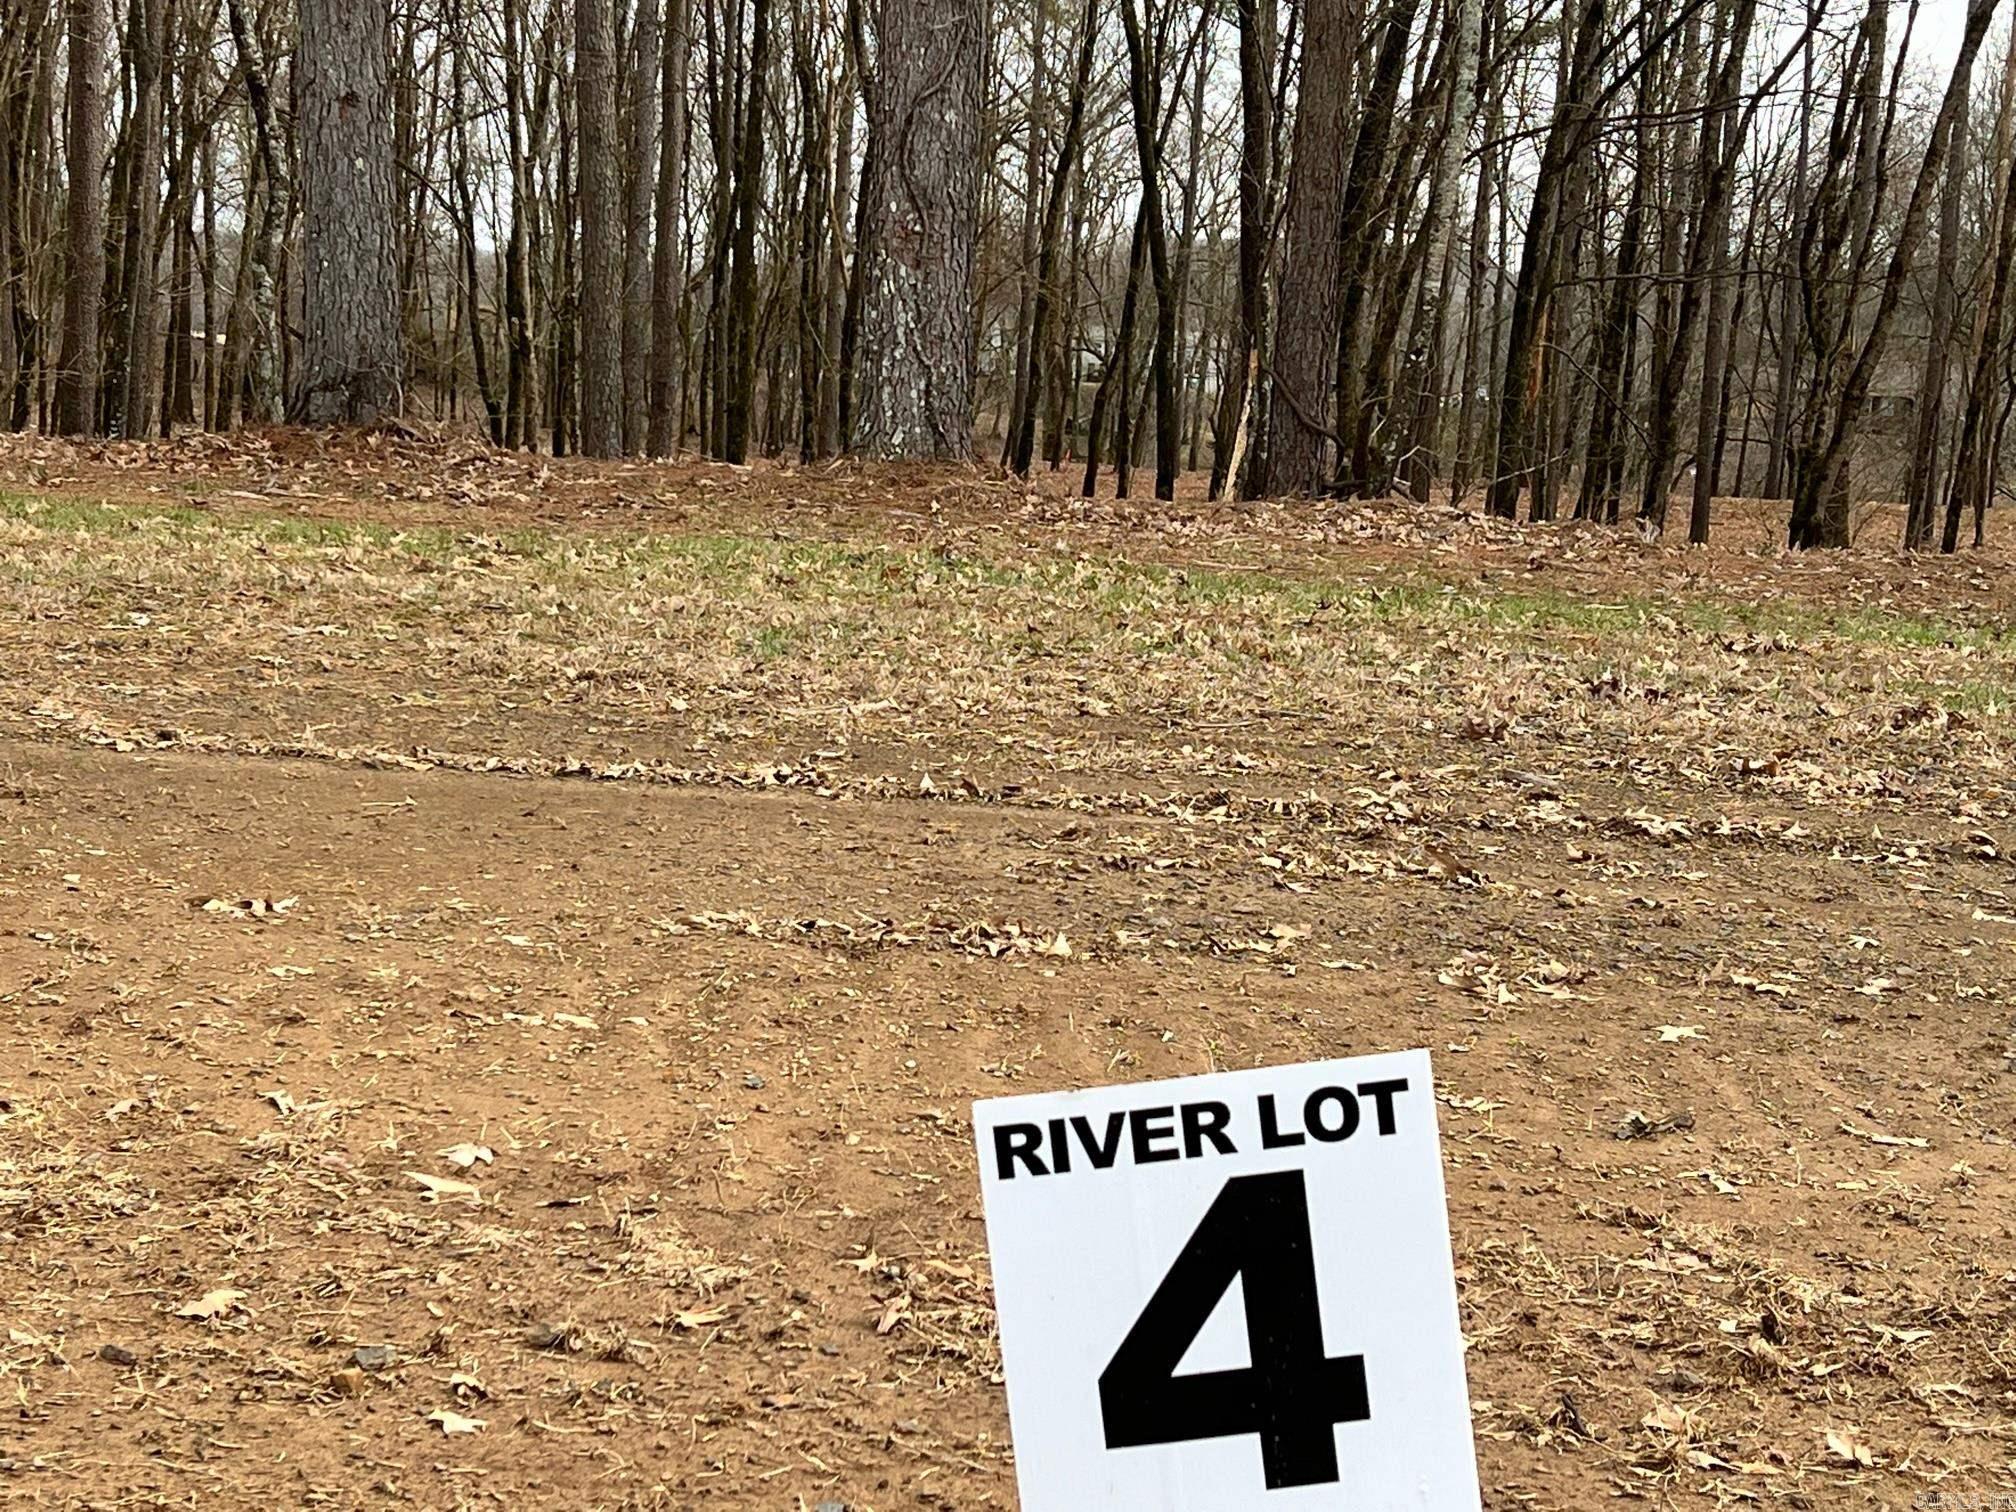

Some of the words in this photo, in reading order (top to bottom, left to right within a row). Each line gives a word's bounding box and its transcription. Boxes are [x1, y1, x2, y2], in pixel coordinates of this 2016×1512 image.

[993, 1102, 1238, 1180] RIVER
[1258, 1079, 1408, 1149] LOT
[1098, 1170, 1370, 1490] 4
